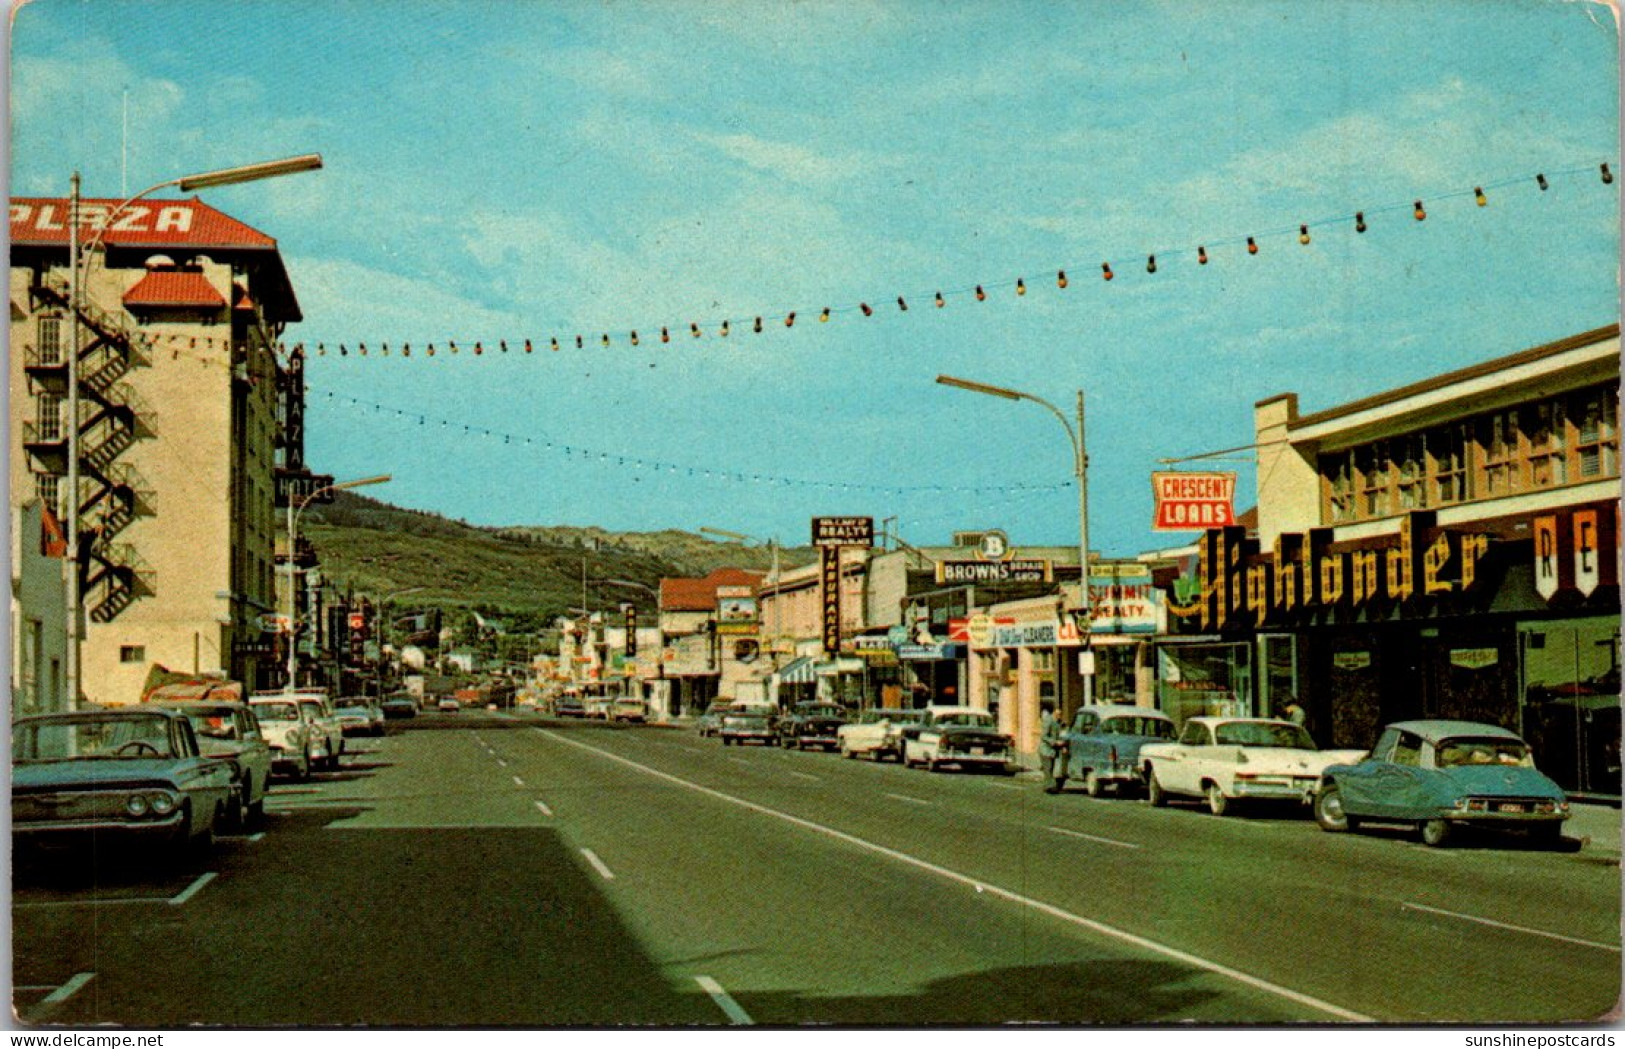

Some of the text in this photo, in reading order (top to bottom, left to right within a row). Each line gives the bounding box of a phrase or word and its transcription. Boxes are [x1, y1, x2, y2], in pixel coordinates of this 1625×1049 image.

[10, 204, 194, 232] PLAZA
[291, 358, 301, 465] PLAZA
[280, 477, 332, 500] HOTEL
[1163, 477, 1229, 499] CRESCENT
[1165, 503, 1228, 524] LOANS
[819, 526, 869, 537] REALTY
[984, 535, 1005, 557] B
[945, 563, 1009, 581] BROWNS
[1199, 515, 1488, 631] Highlander
[827, 547, 837, 648] INSURANCE
[1088, 584, 1152, 602] SUMMIT
